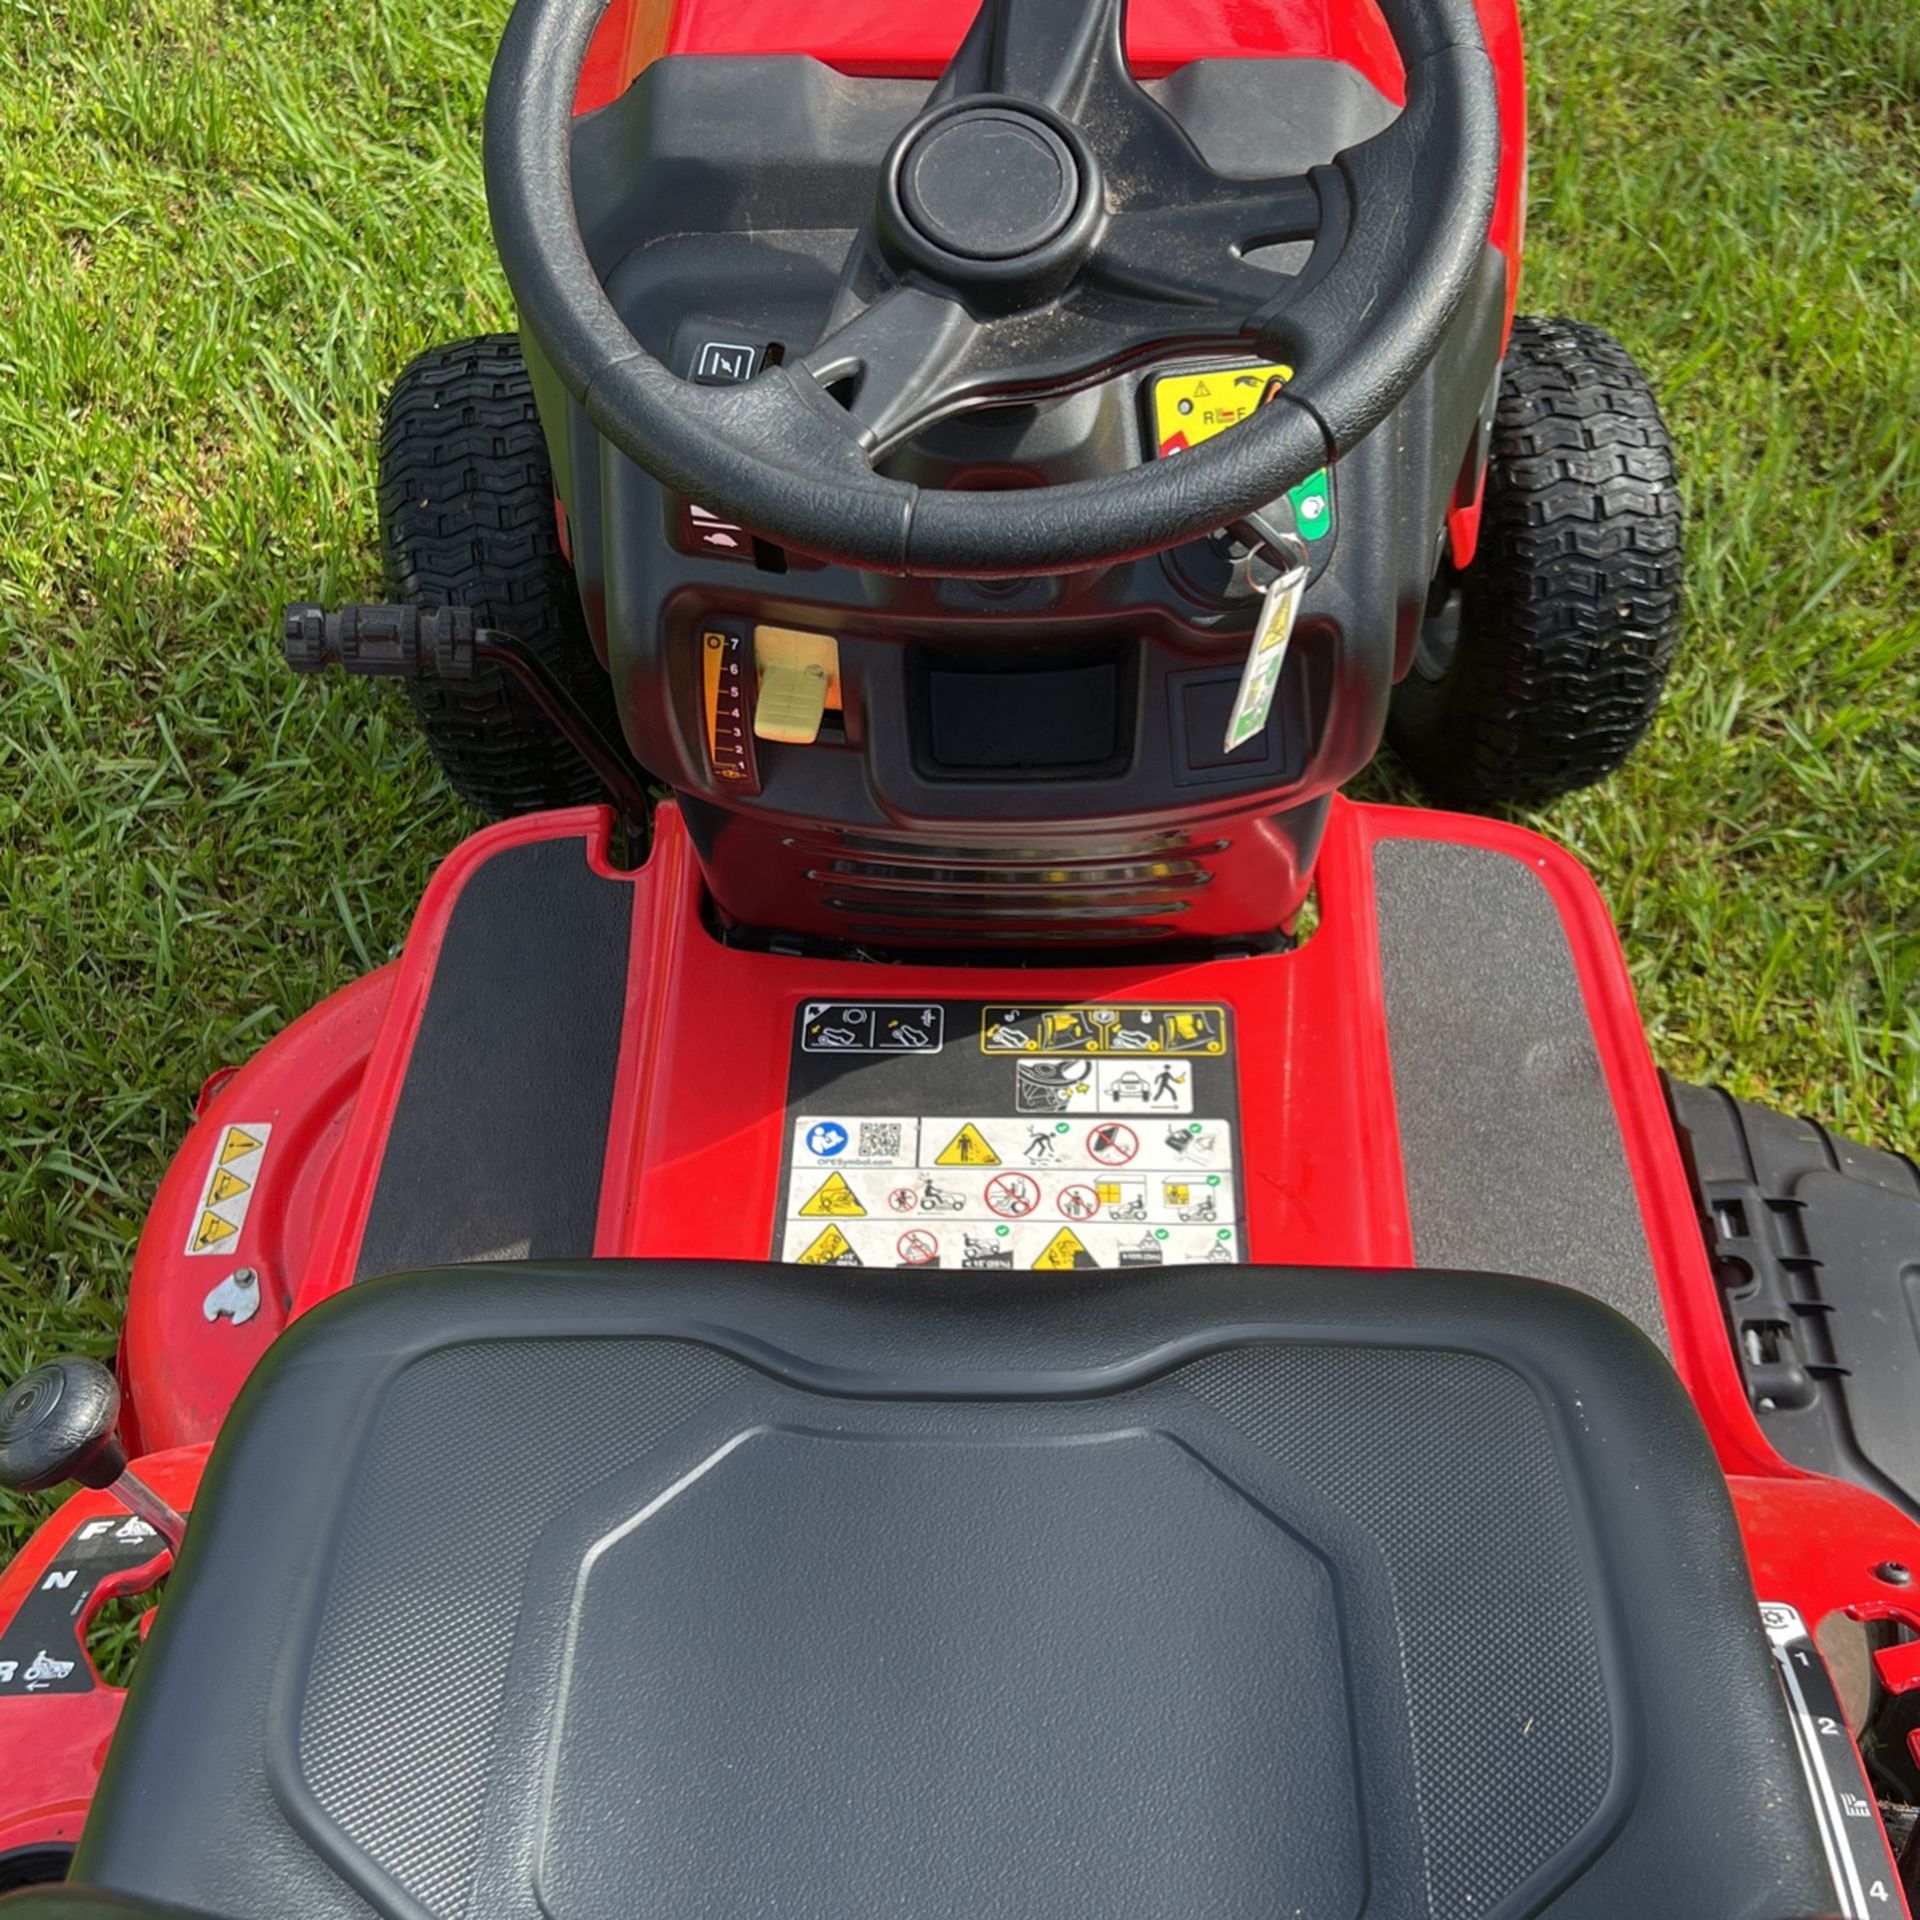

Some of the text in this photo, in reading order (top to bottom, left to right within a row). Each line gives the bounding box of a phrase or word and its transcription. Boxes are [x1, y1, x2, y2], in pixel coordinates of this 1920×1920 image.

[1203, 410, 1215, 425] R
[730, 638, 739, 650] 7
[730, 663, 739, 675] 6
[730, 687, 739, 698] 5
[731, 708, 740, 718] 4
[733, 727, 742, 737] 3
[735, 745, 743, 754] 2
[738, 761, 745, 769] 1
[78, 1521, 116, 1541] F
[41, 1570, 78, 1590] N
[1795, 1652, 1810, 1668] 1
[0, 1660, 19, 1682] R
[1817, 1717, 1840, 1736] 2
[1869, 1880, 1889, 1902] 4
